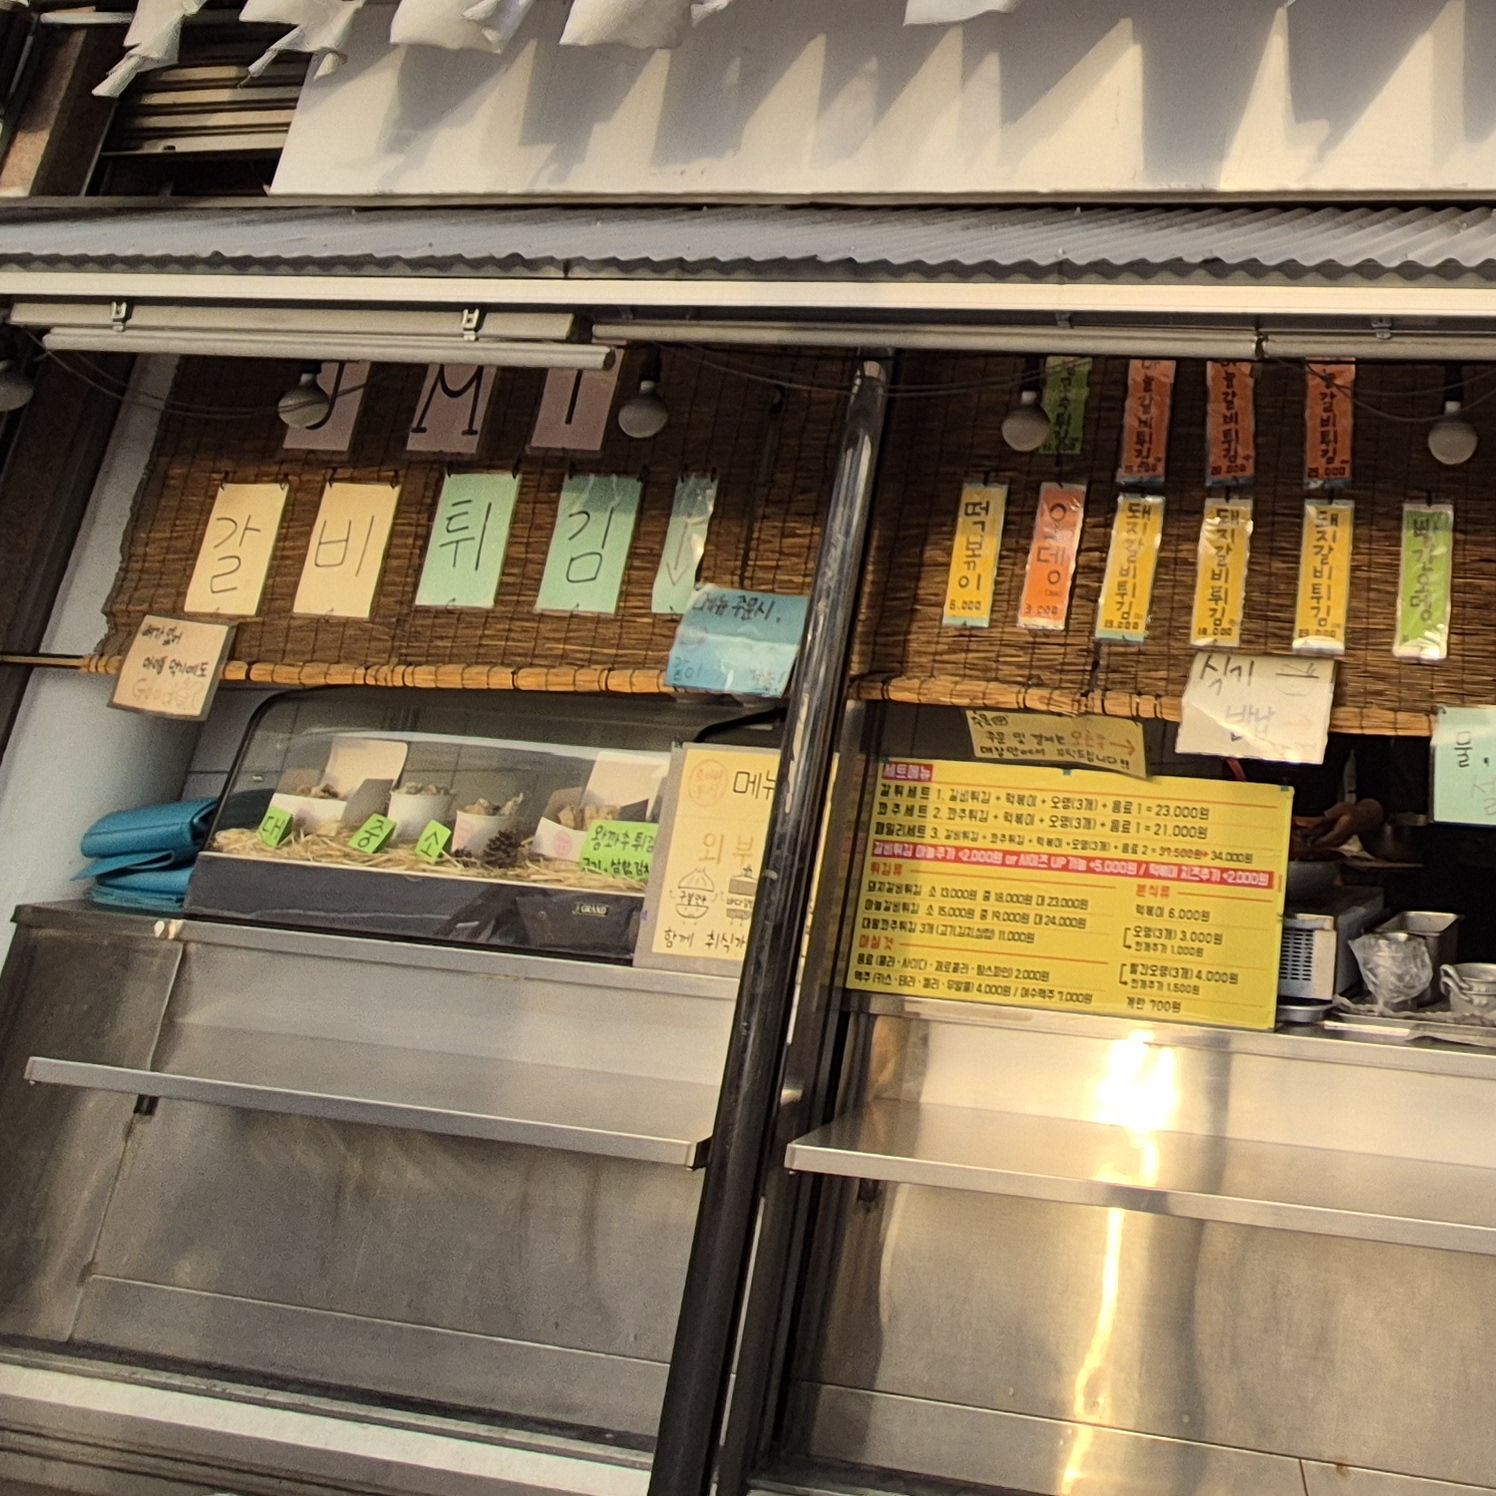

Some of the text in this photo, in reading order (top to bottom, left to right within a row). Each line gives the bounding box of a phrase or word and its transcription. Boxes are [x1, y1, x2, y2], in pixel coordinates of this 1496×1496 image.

[957, 500, 991, 591] 떡볶이
[1115, 502, 1152, 621] 돼지갈비튀김
[1207, 508, 1240, 627] 돼지갈비튀김
[1309, 510, 1340, 628] 돼지갈비튀김
[1200, 654, 1256, 697] 식기
[732, 770, 776, 801] 메뉴
[949, 788, 991, 804] 갈비튀김
[1006, 793, 1037, 807] 떡볶이
[1155, 804, 1210, 820] 23.000원
[261, 815, 286, 842] 대
[357, 819, 385, 849] 중
[1004, 811, 1035, 826] 떡볶이
[1154, 823, 1208, 839] 21.000원
[419, 830, 440, 858] 소
[699, 832, 755, 865] 외부
[664, 927, 695, 949] 함께
